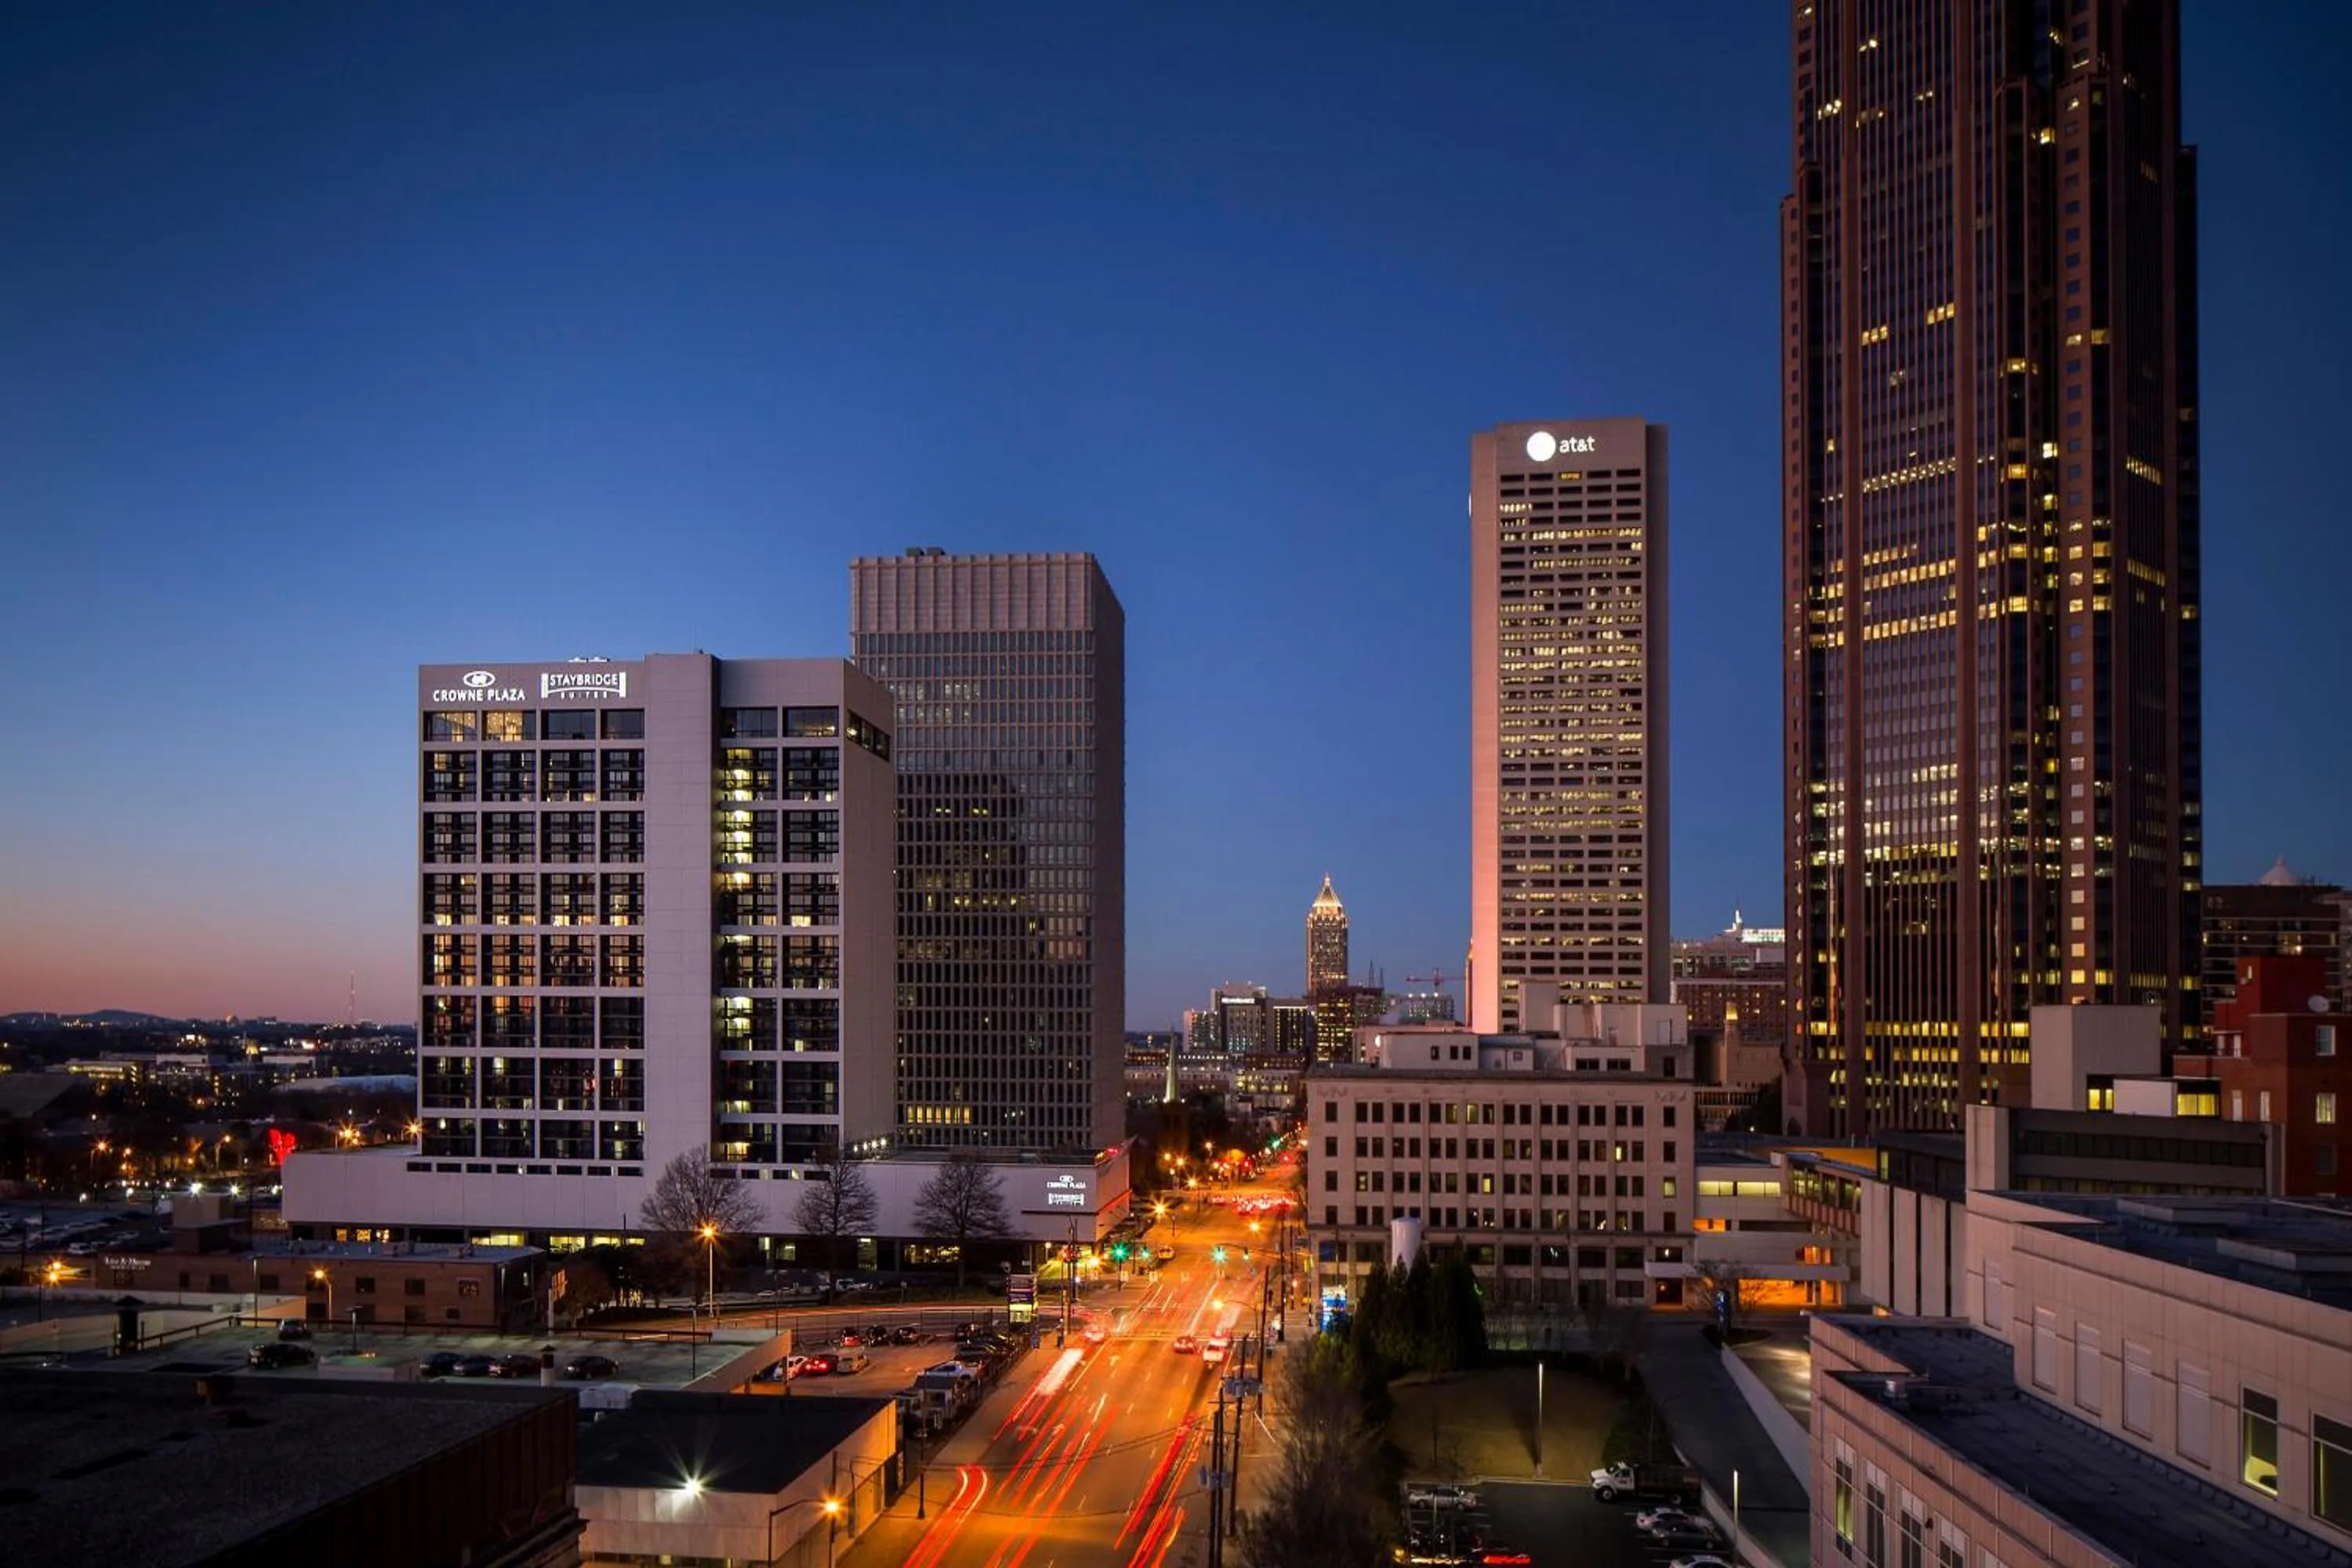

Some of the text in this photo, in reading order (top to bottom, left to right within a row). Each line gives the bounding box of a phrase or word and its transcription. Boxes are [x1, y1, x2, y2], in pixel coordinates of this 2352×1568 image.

[1559, 436, 1595, 453] at&t
[550, 673, 619, 686] STAYBRIDGE
[432, 688, 525, 702] CROWNE PLAZA
